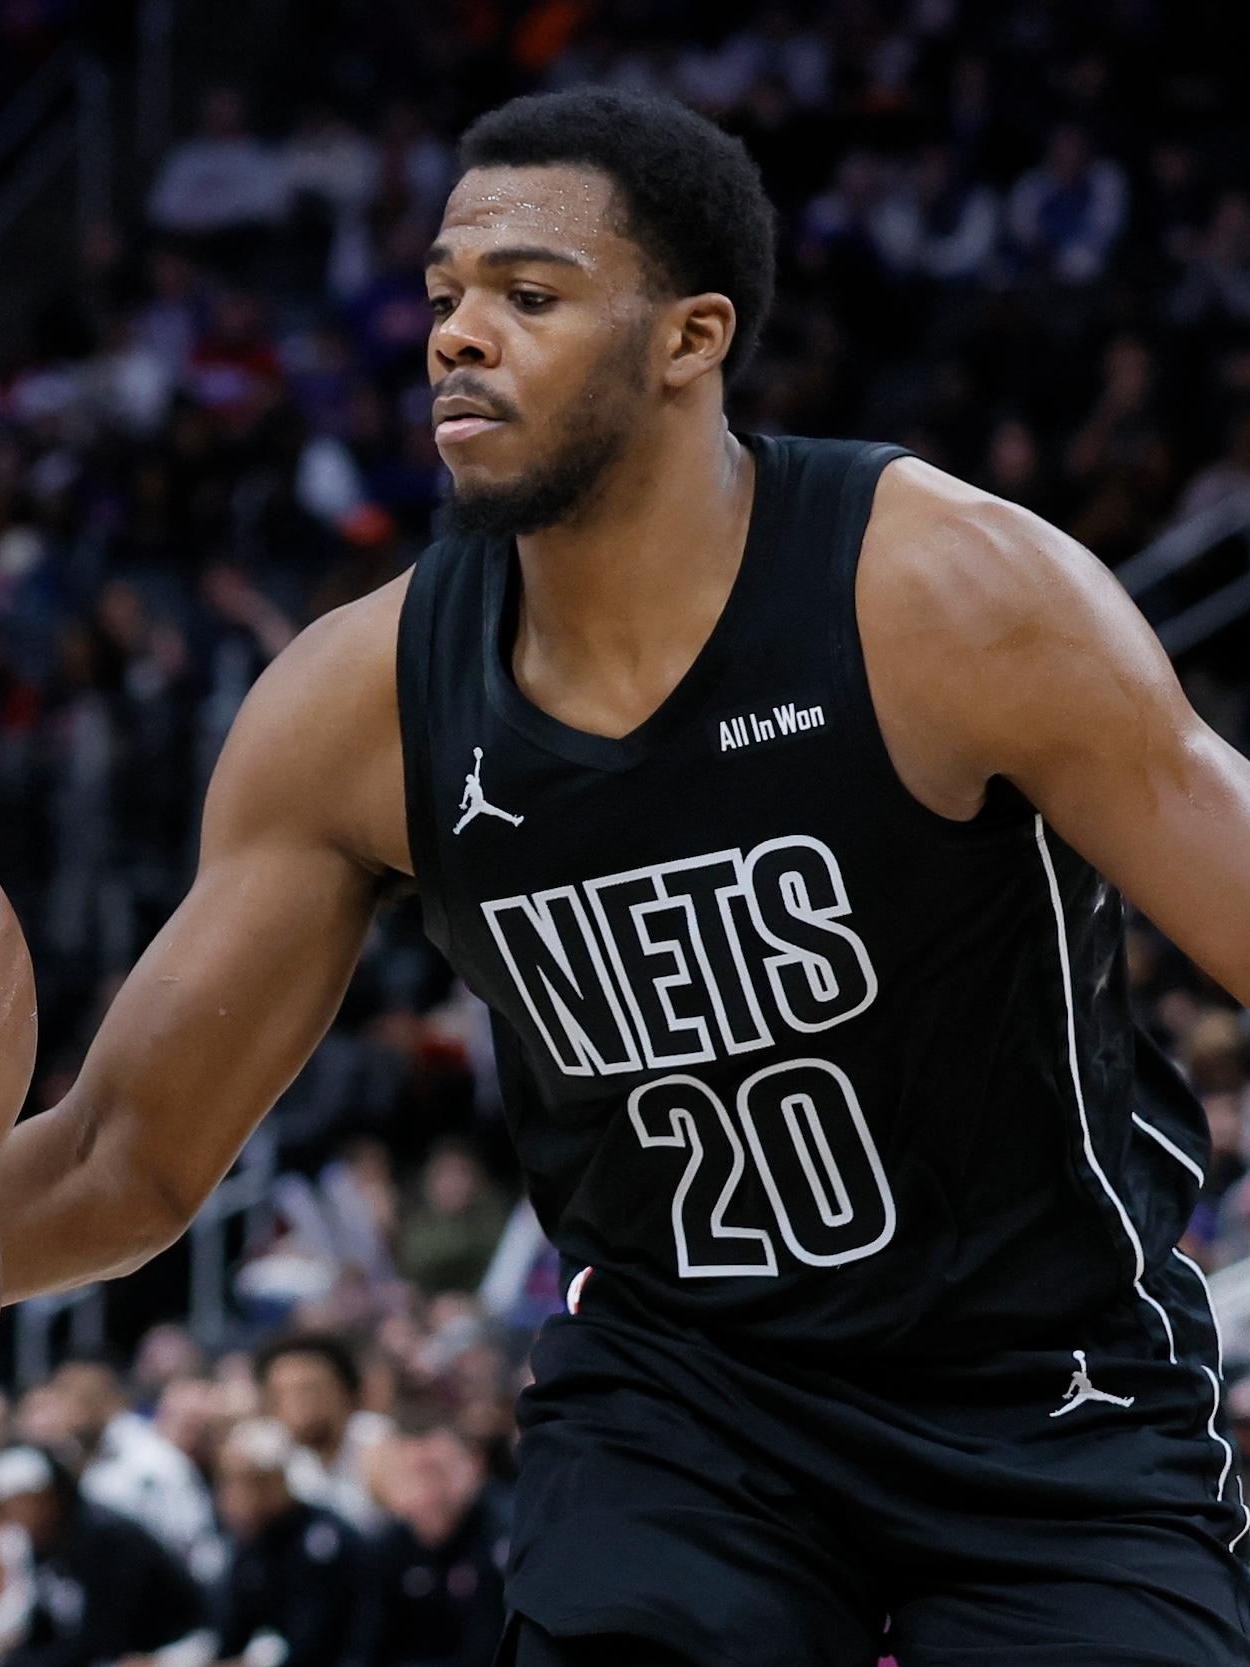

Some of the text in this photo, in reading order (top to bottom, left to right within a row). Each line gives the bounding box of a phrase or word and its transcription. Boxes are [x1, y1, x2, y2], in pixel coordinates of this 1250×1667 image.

[719, 702, 825, 752] All In Won
[481, 834, 878, 1077] NETS
[627, 1058, 897, 1279] 20
